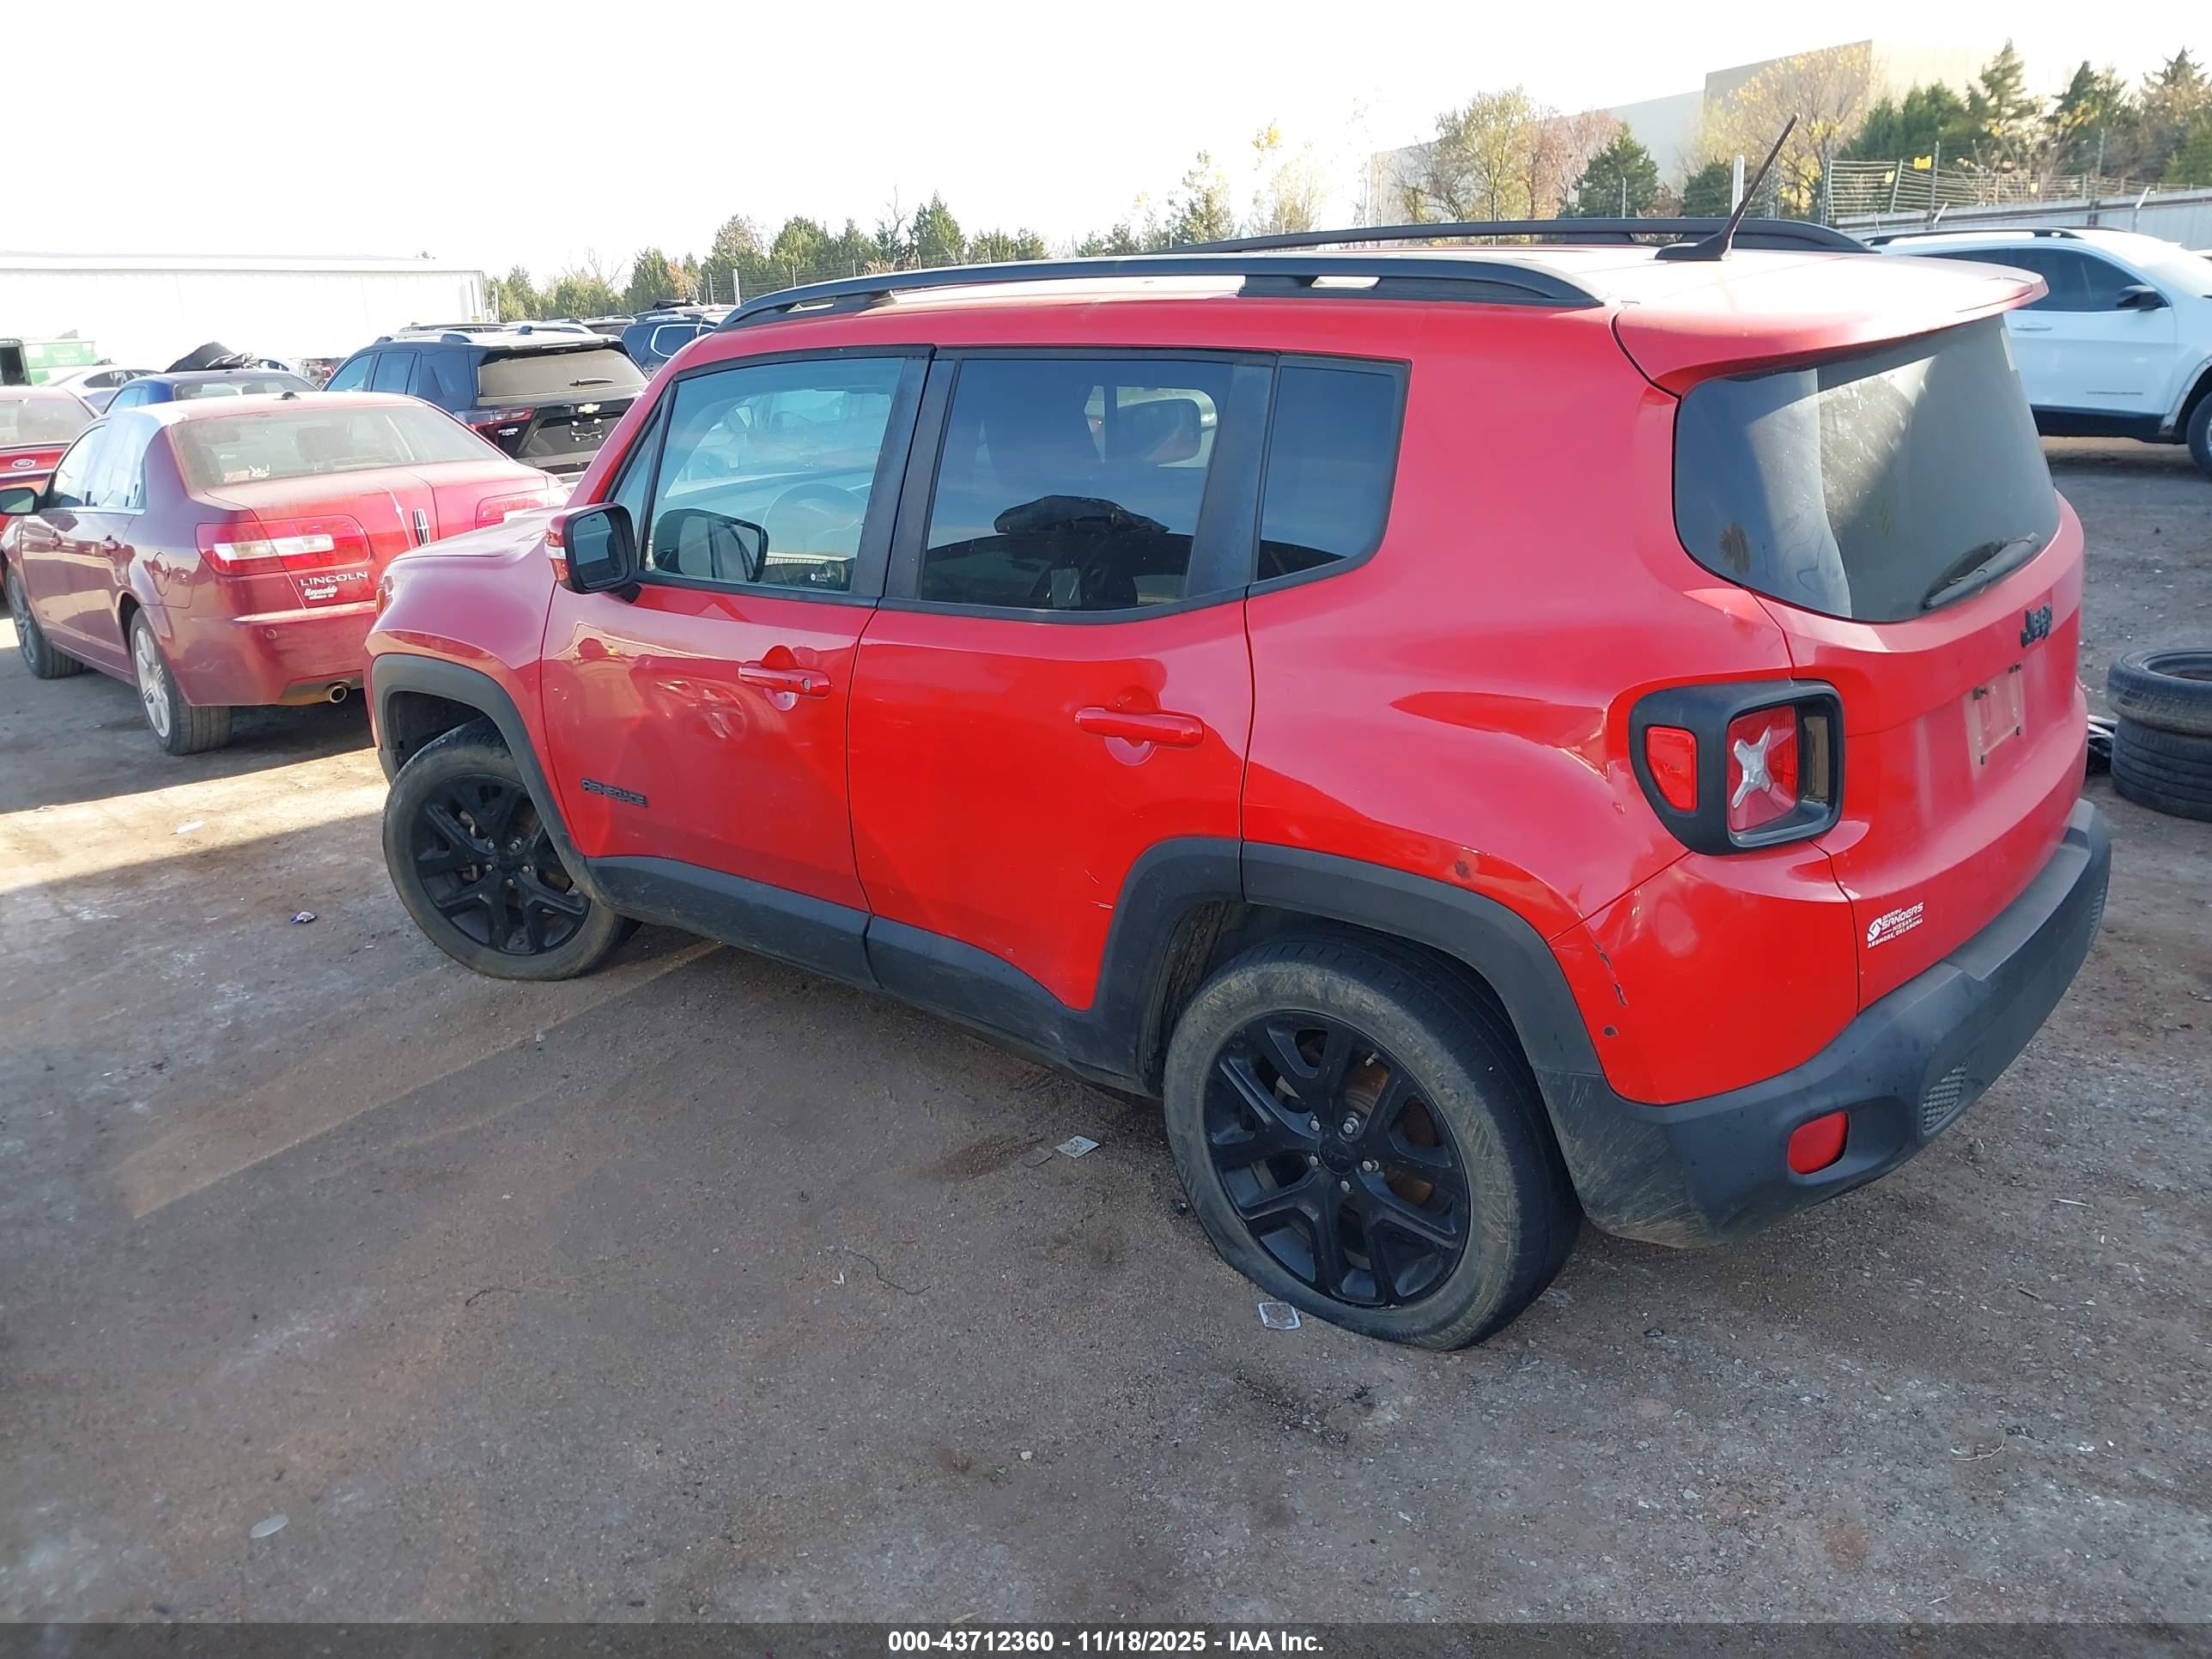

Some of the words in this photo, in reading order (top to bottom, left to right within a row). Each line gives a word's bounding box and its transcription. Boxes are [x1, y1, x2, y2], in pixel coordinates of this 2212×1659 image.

[299, 571, 368, 586] LINCOLN
[2021, 605, 2051, 647] Jeep
[580, 777, 647, 807] RENEGADE
[1881, 902, 1923, 930] SANDERS
[1893, 918, 1912, 932] NISSAN
[1895, 918, 1923, 936] OKLAHOMA
